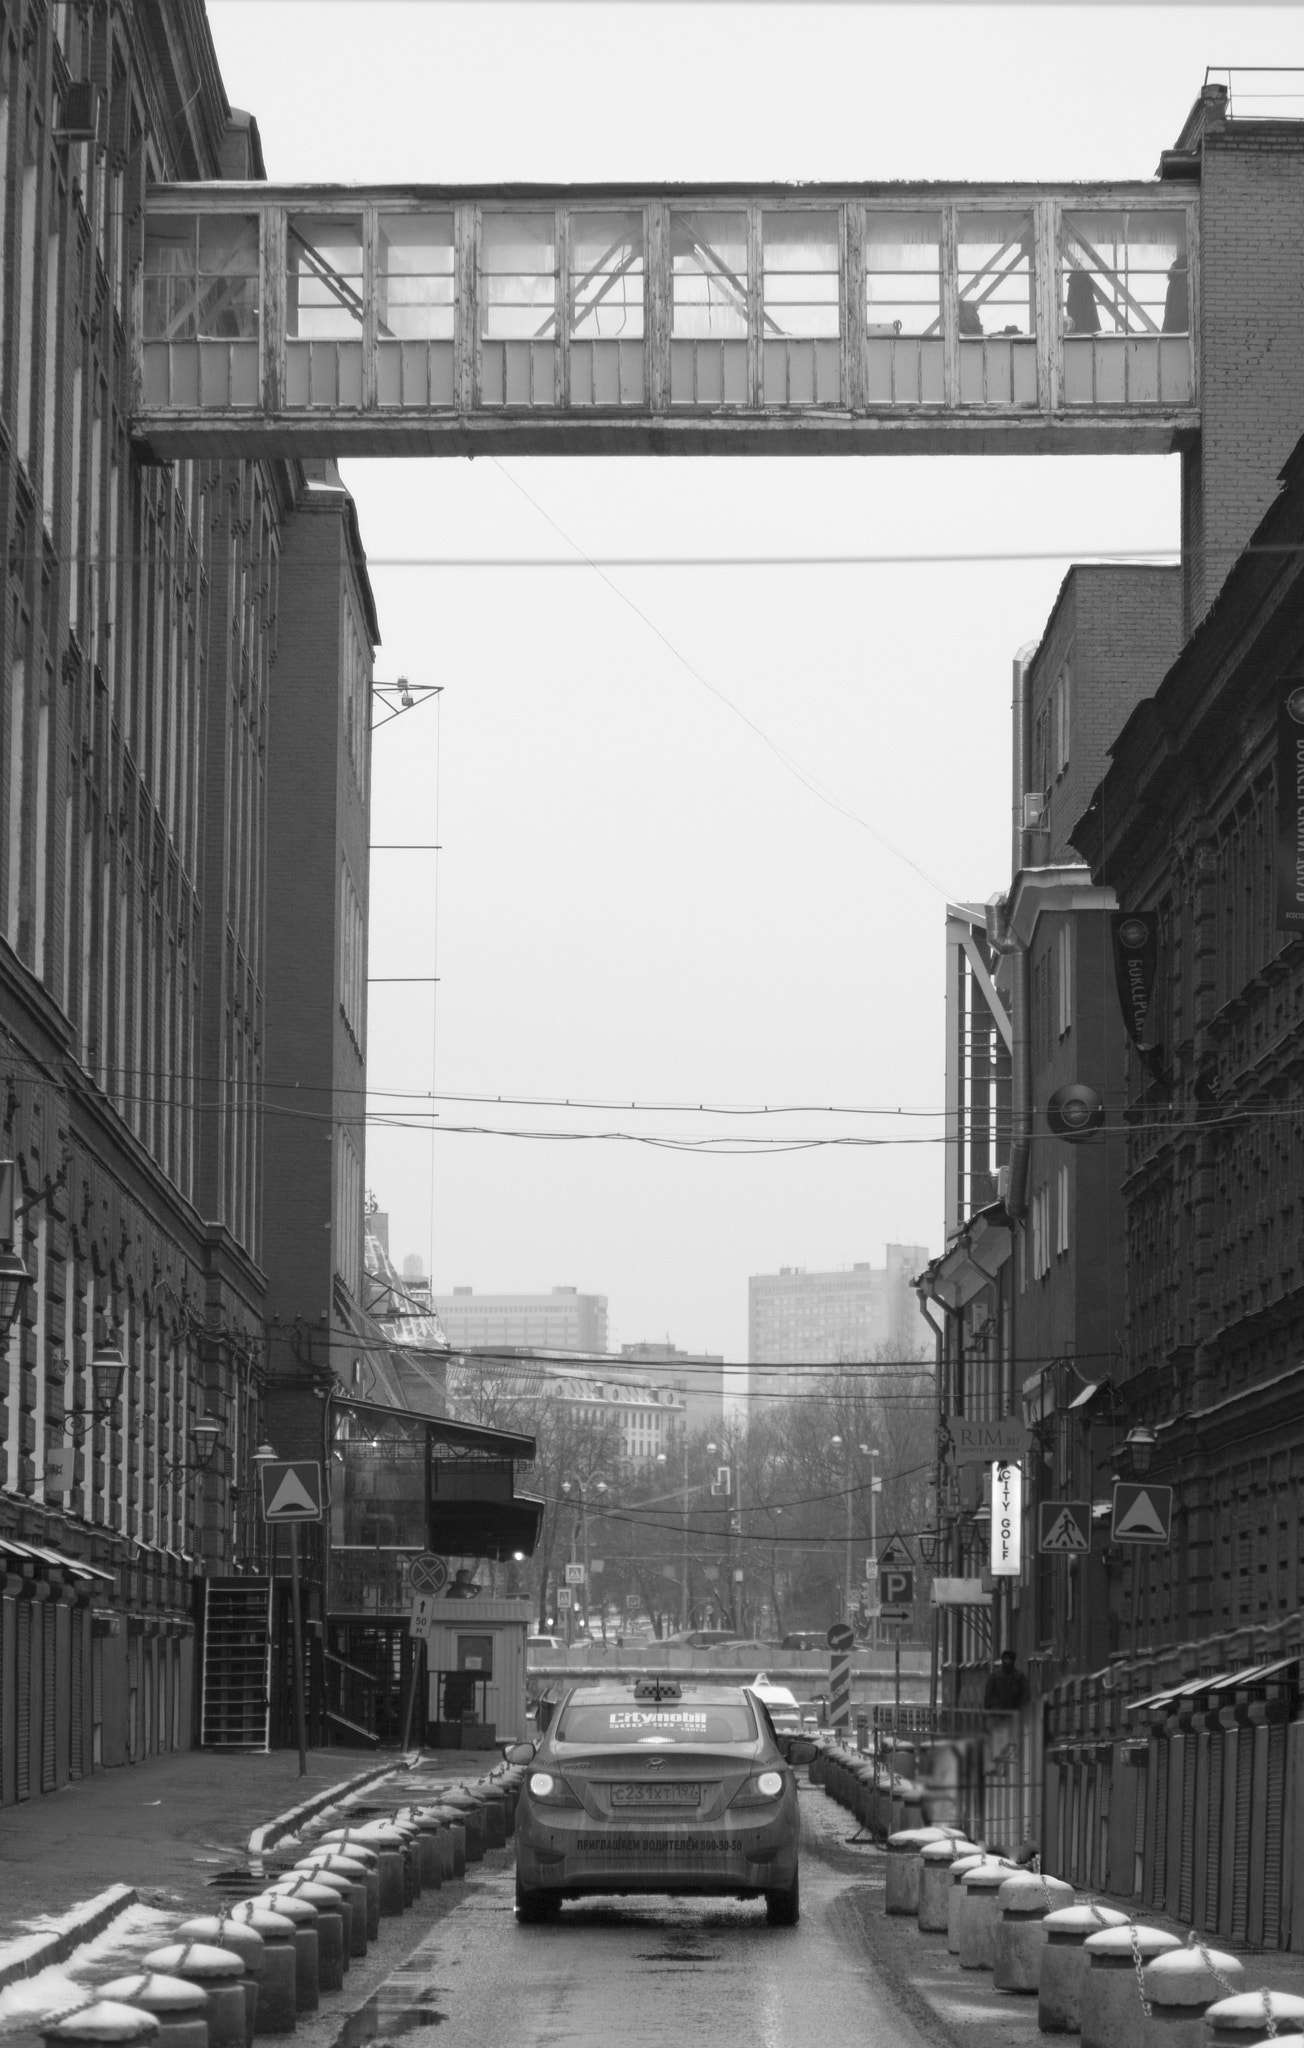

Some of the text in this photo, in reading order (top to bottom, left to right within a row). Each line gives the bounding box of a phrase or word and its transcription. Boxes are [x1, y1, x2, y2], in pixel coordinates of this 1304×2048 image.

[961, 1429, 1003, 1446] RIM
[1001, 1469, 1011, 1560] CITY GOLF
[888, 1574, 907, 1602] P
[415, 1616, 427, 1626] 50
[609, 1712, 707, 1723] Citymobil
[576, 1839, 742, 1851] ПРИГЛАШАЕМ ВОДИТЕЛЕЙ 500-50-50
